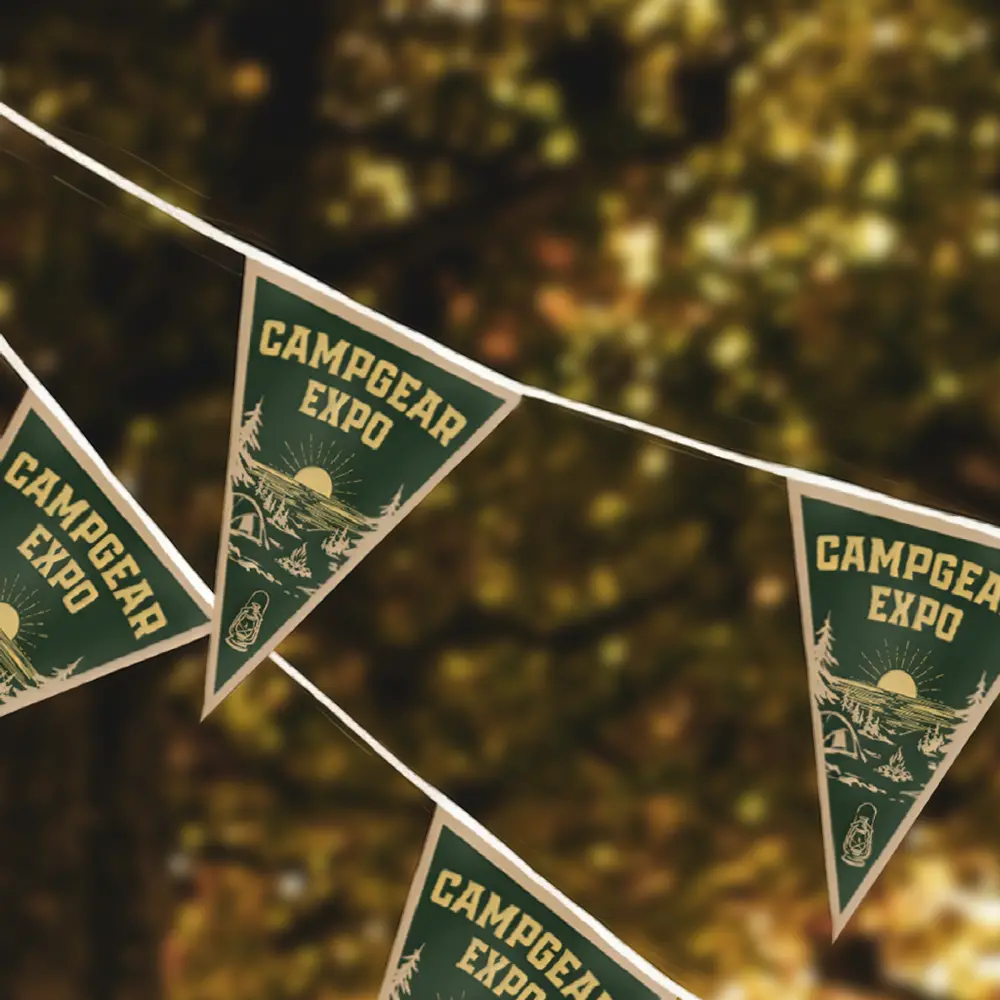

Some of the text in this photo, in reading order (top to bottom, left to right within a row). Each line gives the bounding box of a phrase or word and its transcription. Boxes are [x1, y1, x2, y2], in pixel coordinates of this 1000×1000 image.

[258, 319, 468, 447] CAMPGEAR
[298, 380, 394, 450] EXPO
[4, 451, 168, 640] CAMPGEAR
[17, 524, 99, 614] EXPO
[867, 585, 964, 642] EXPO
